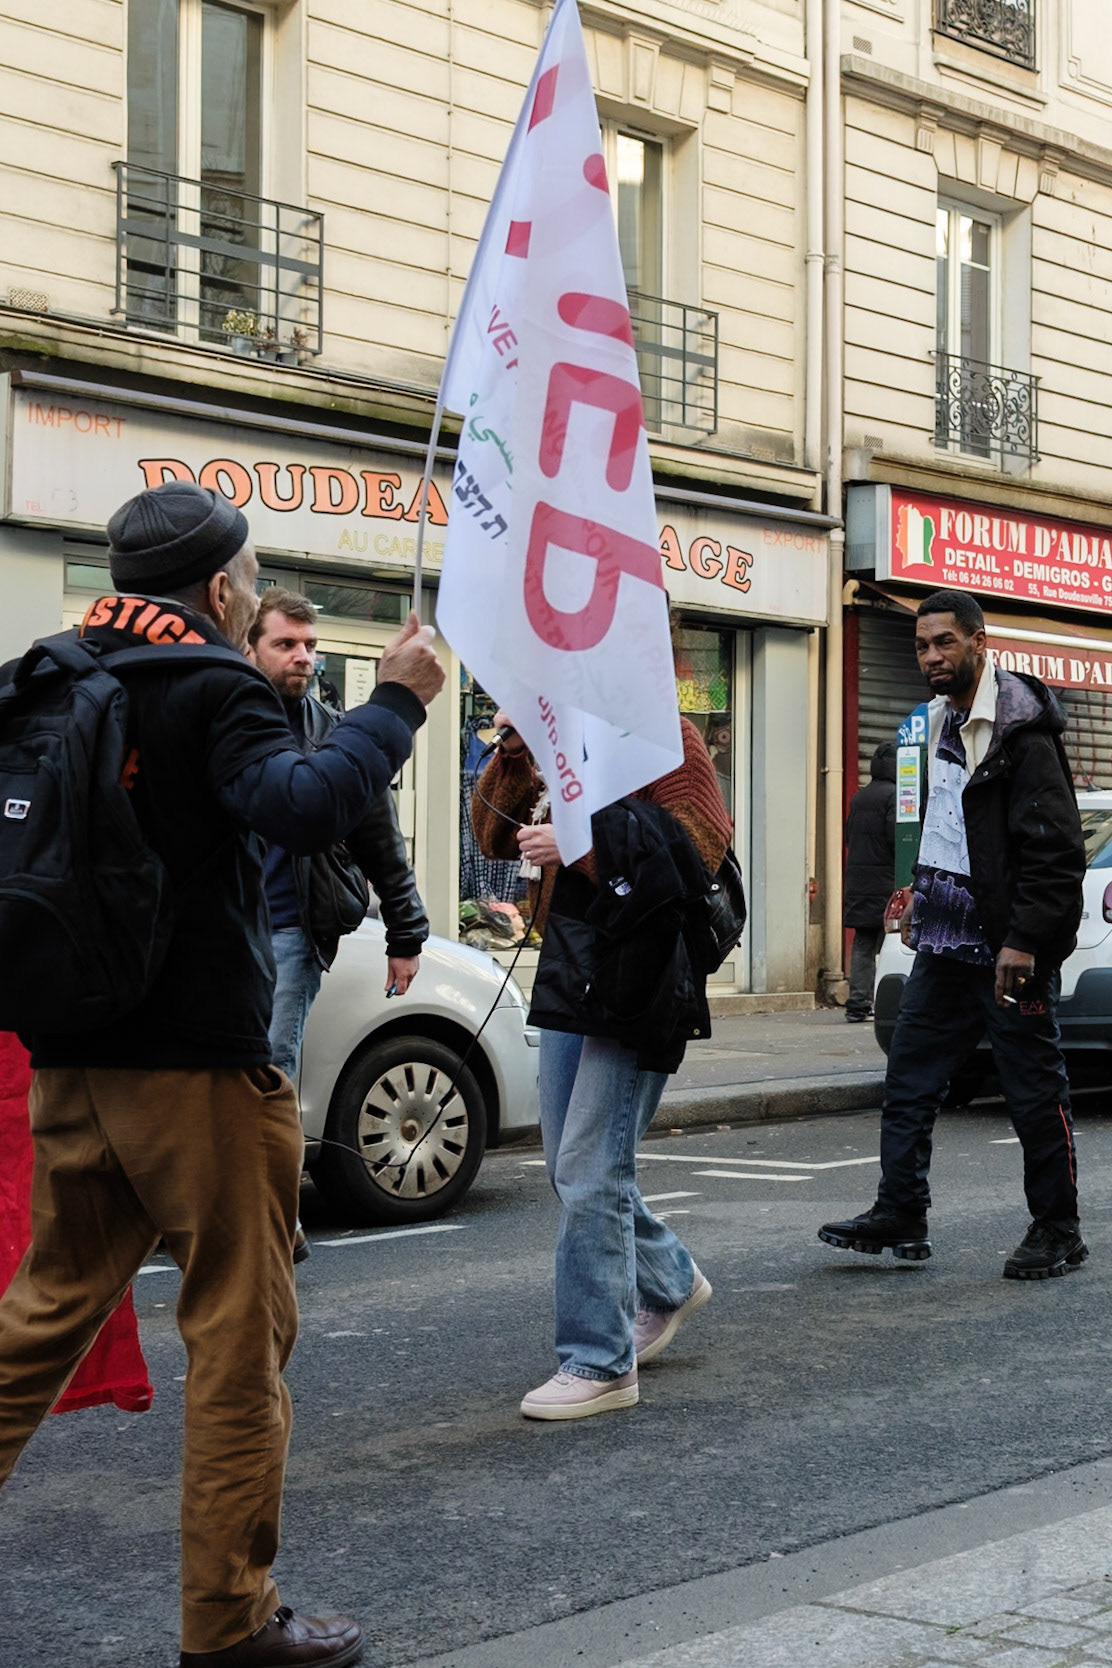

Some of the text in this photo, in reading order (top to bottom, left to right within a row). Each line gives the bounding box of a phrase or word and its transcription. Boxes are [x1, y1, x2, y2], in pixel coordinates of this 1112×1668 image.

[27, 402, 126, 438] IMPORT
[338, 529, 367, 553] AU
[763, 528, 825, 553] EXPORT
[939, 507, 1028, 554] FORUM
[944, 548, 1000, 573] DETAIL
[1013, 560, 1090, 588] DEMIGROS
[959, 572, 970, 583] 06
[970, 574, 981, 585] 24
[982, 576, 992, 587] 26
[993, 578, 1003, 589] 06
[1004, 580, 1014, 591] 02
[1043, 586, 1057, 599] Rue
[1058, 588, 1103, 605] Doudeauville
[80, 596, 206, 644] STIC
[985, 647, 1066, 681] FORUM
